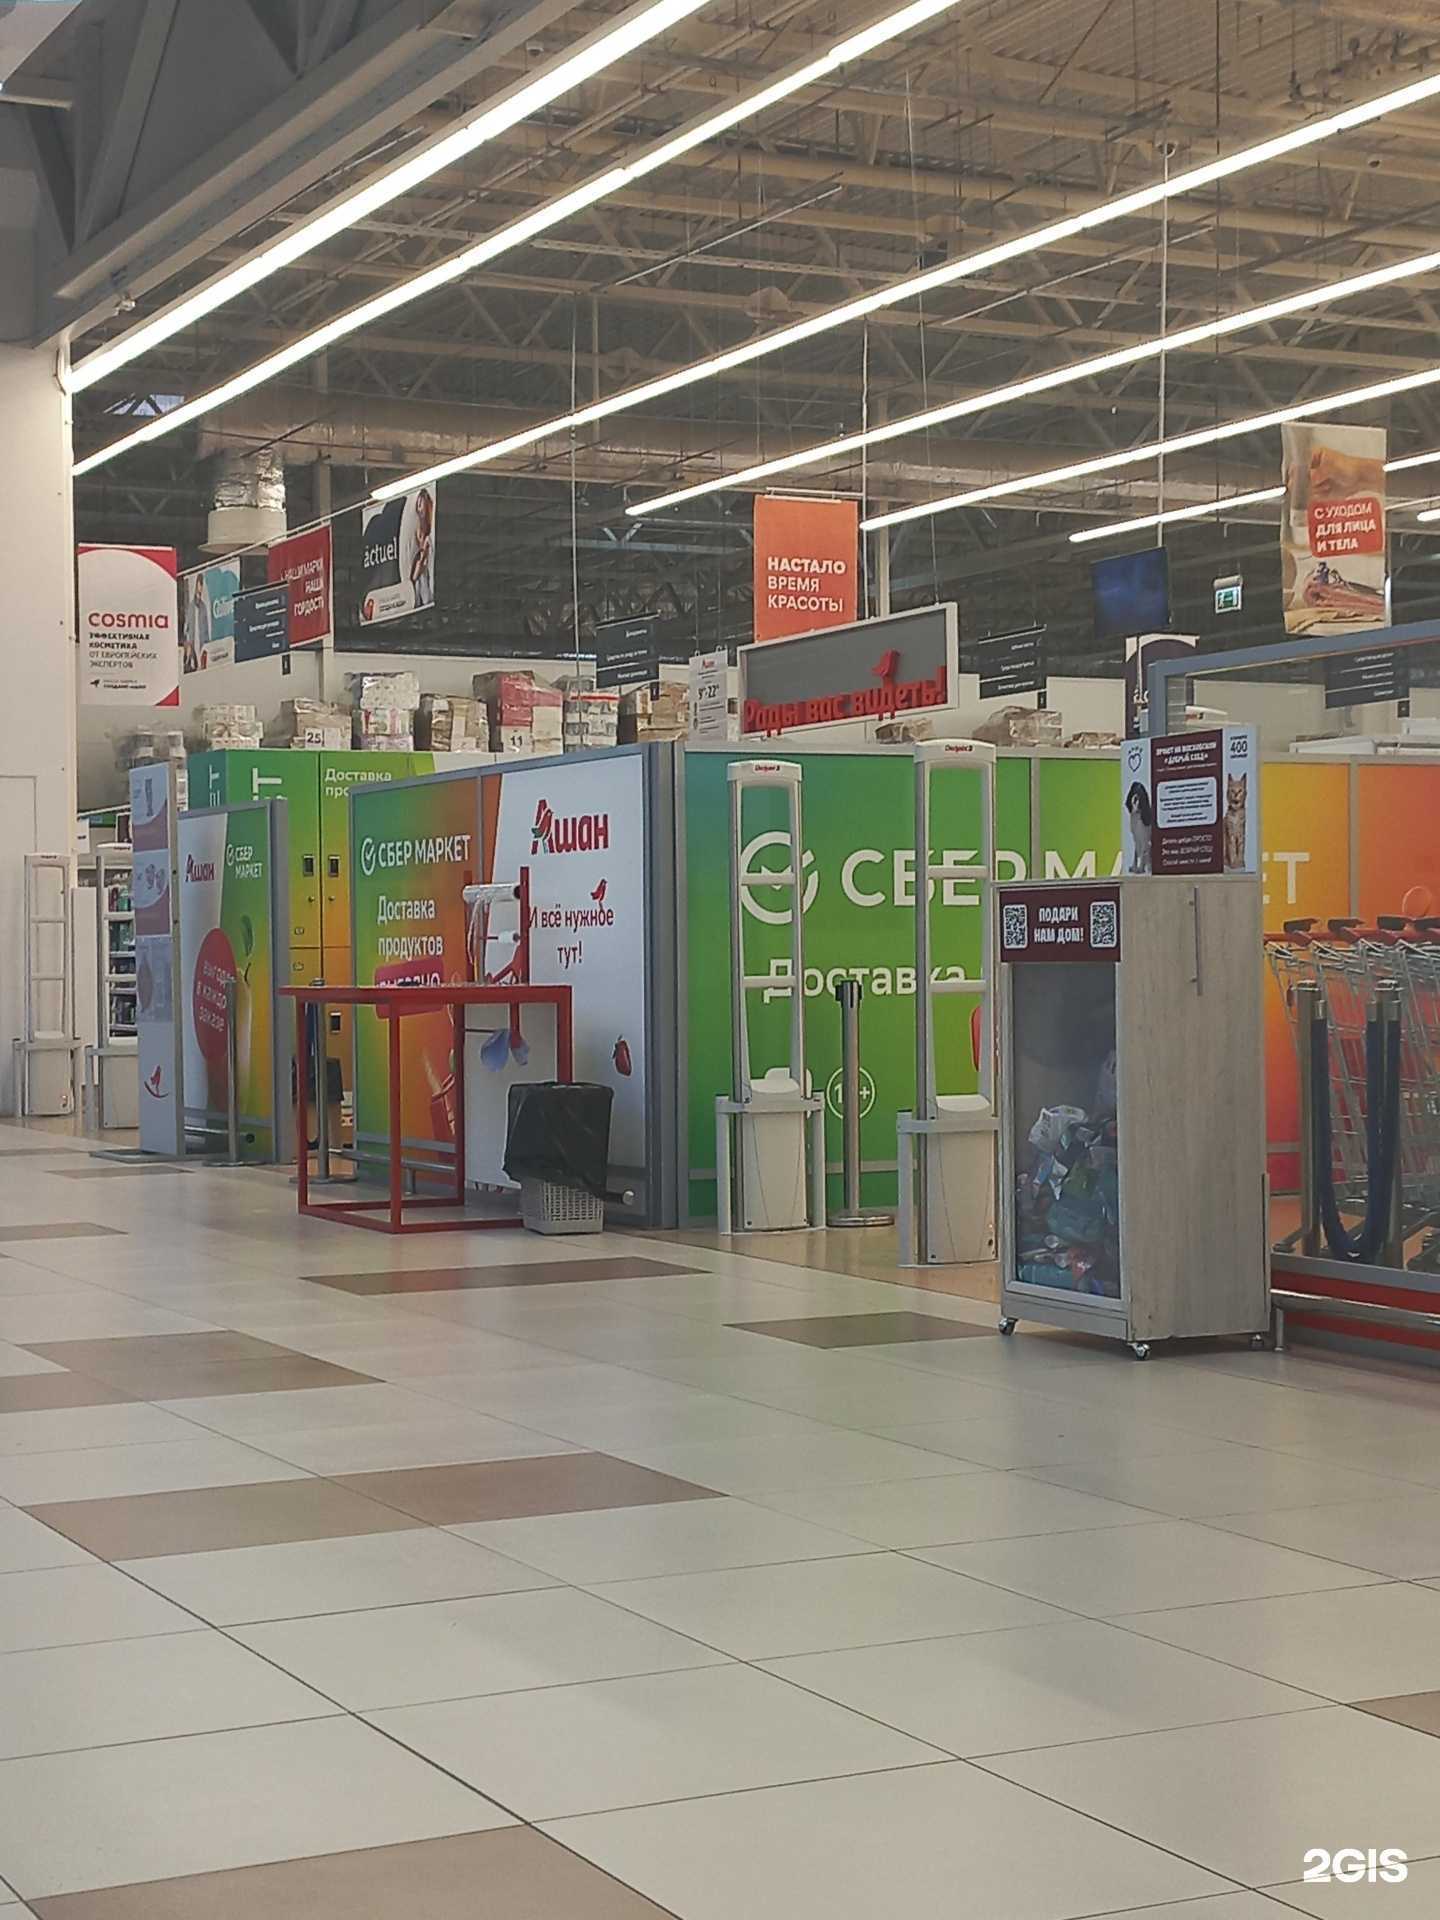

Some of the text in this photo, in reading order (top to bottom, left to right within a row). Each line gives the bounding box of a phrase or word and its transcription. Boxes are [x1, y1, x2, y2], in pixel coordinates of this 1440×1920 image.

[1314, 502, 1372, 519] С УХОДОМ
[1315, 519, 1376, 538] ДЛЯ ЛИЦА
[1317, 538, 1359, 553] И ТЕЛА
[767, 556, 846, 574] НАСТАЛО
[767, 576, 820, 592] ВРЕМЯ
[767, 594, 844, 612] КРАСОТЫ
[88, 612, 168, 629] cosmia
[745, 698, 799, 737] Рады
[806, 695, 845, 724] вас
[854, 666, 946, 722] видеть!
[307, 731, 321, 744] 25
[1230, 740, 1248, 753] 400
[324, 768, 392, 783] Доставка
[532, 799, 609, 856] Ашан
[378, 835, 471, 868] СБЕР МАРКЕТ
[377, 896, 435, 925] Доставка
[541, 904, 562, 928] всё
[565, 905, 615, 933] нужное
[1039, 907, 1078, 924] ПОДАРИ
[1034, 928, 1084, 945] НАМ ДОМ!
[378, 936, 443, 961] продуктов
[557, 940, 582, 969] тут!
